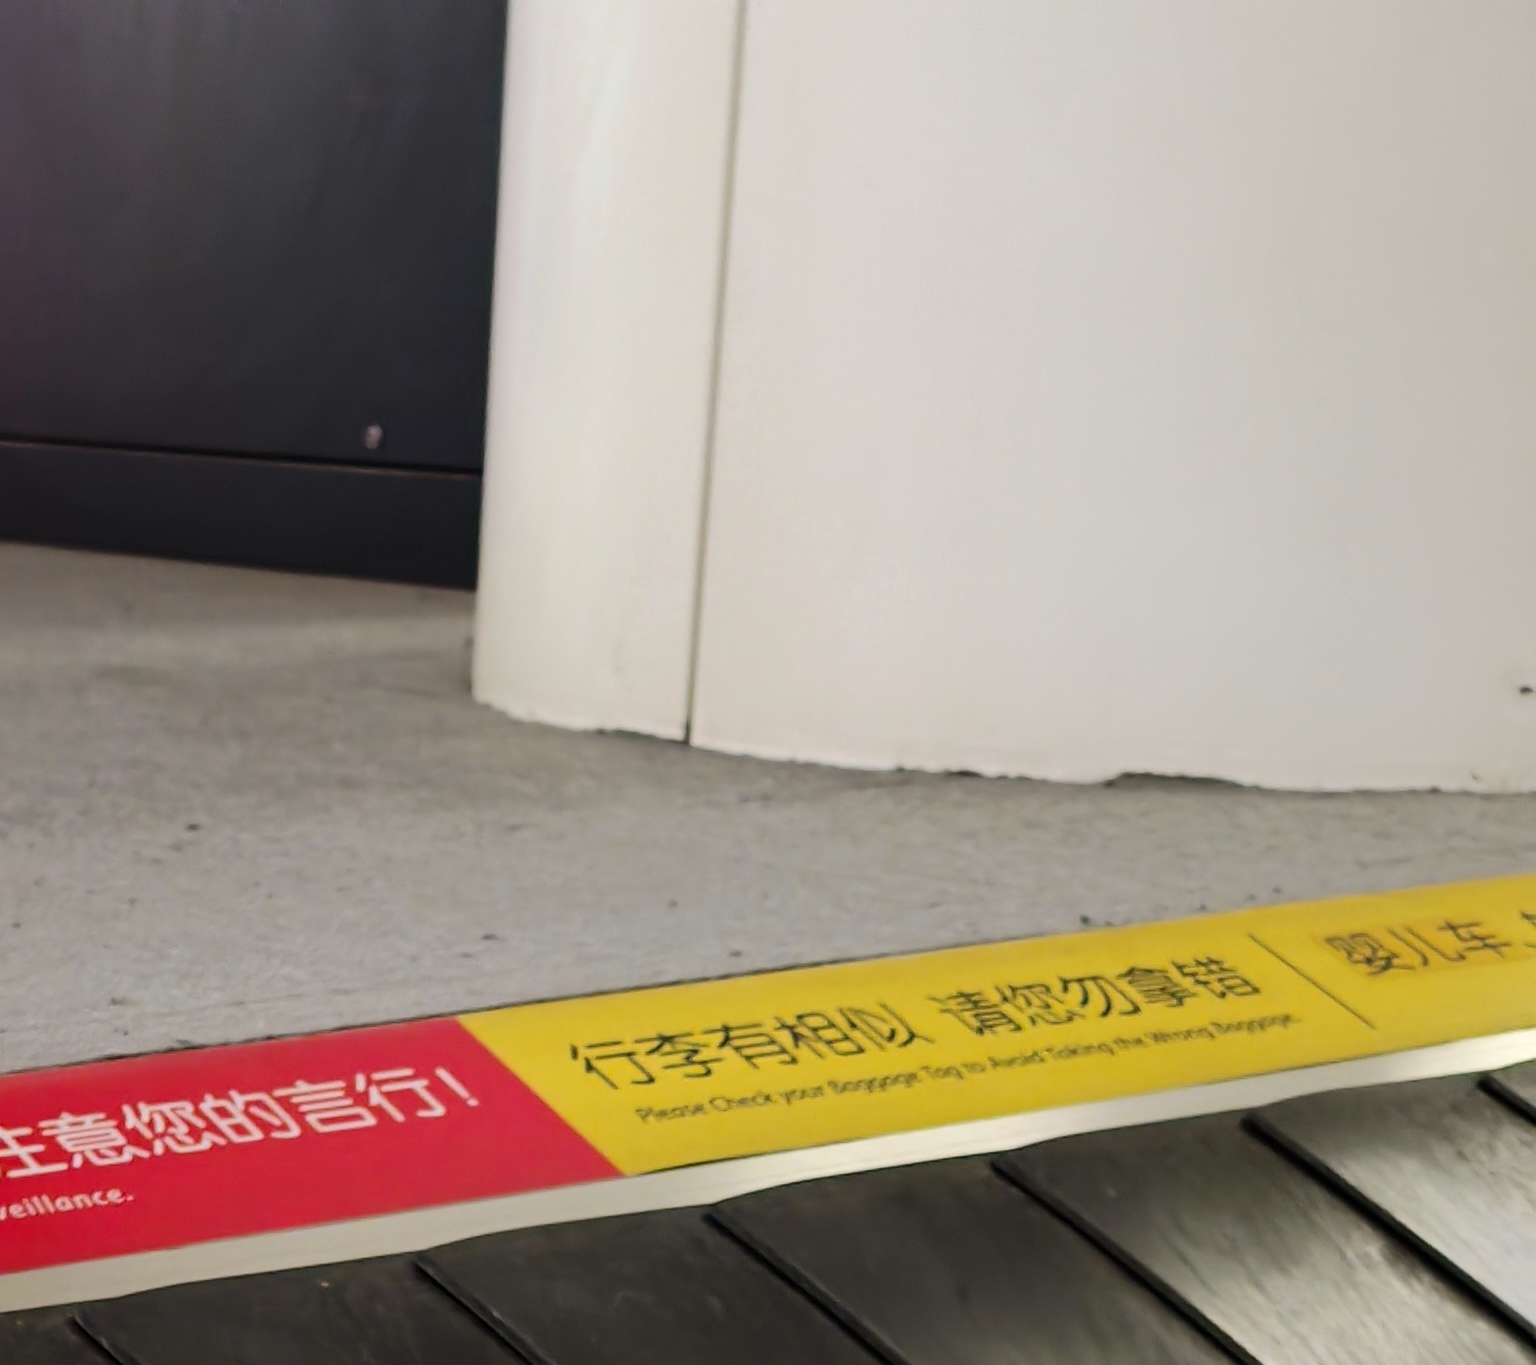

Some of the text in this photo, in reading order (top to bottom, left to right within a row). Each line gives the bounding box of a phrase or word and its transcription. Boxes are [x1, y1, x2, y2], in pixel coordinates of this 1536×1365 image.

[1324, 910, 1536, 977] 婴儿车
[569, 955, 1262, 1091] 行李有相似 请您勿拿错
[635, 1103, 706, 1123] Please
[709, 1090, 774, 1112] Check
[779, 1086, 825, 1106] your
[920, 1062, 964, 1080] Tag
